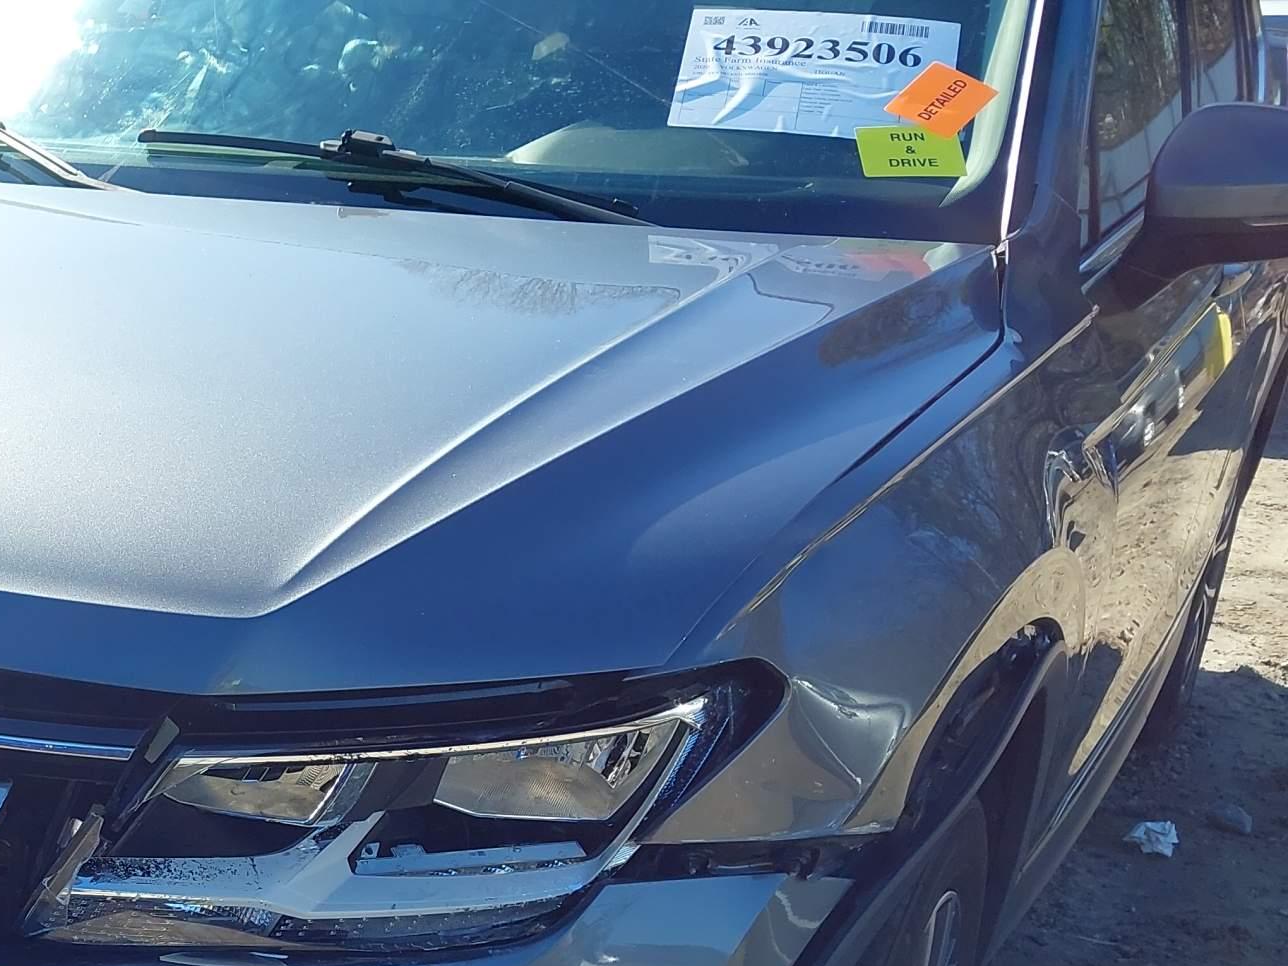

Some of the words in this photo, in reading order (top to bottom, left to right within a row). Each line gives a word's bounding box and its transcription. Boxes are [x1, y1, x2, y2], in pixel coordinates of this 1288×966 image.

[713, 34, 923, 67] 43923506
[724, 56, 752, 65] Farm
[918, 79, 968, 122] DETAILED
[890, 132, 925, 143] RUN
[905, 145, 916, 154] &
[888, 158, 939, 168] DRIVE
